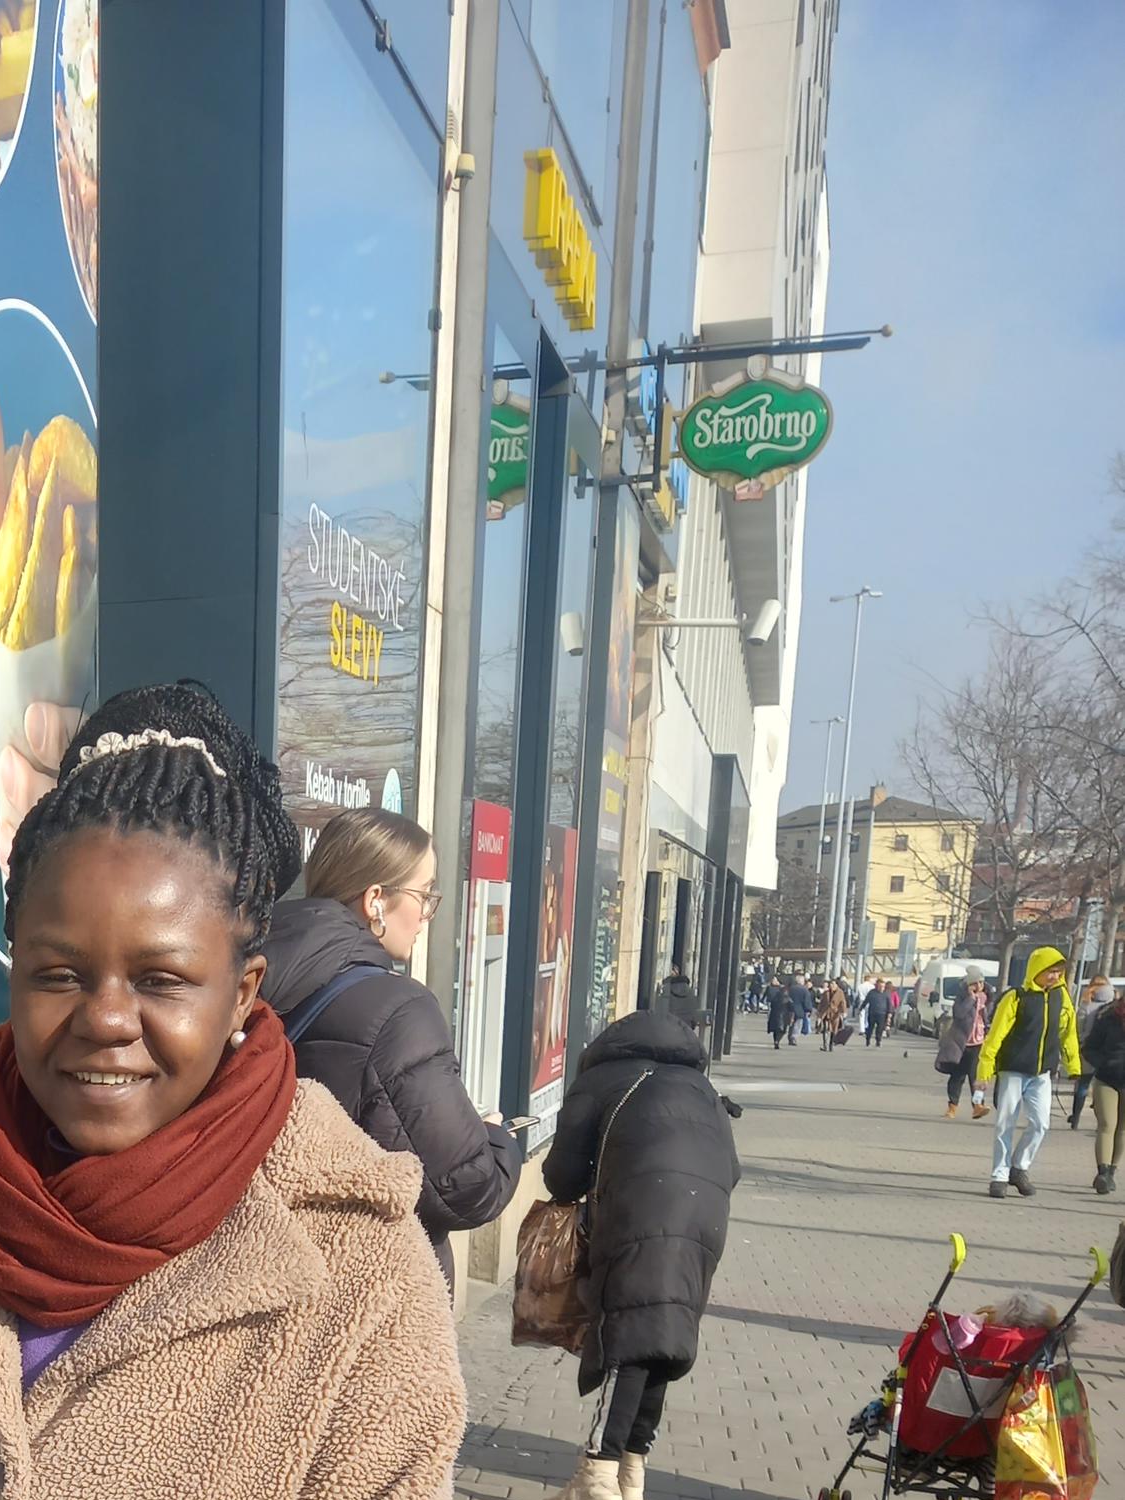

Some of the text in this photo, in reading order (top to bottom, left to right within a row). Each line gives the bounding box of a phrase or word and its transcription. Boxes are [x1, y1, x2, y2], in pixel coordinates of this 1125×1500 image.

[693, 393, 817, 460] Starobrno
[308, 502, 406, 632] STUDENTSKÉ
[330, 600, 384, 688] SLEVY
[305, 760, 335, 803] Kebab
[336, 779, 343, 806] v
[343, 775, 371, 809] tortille
